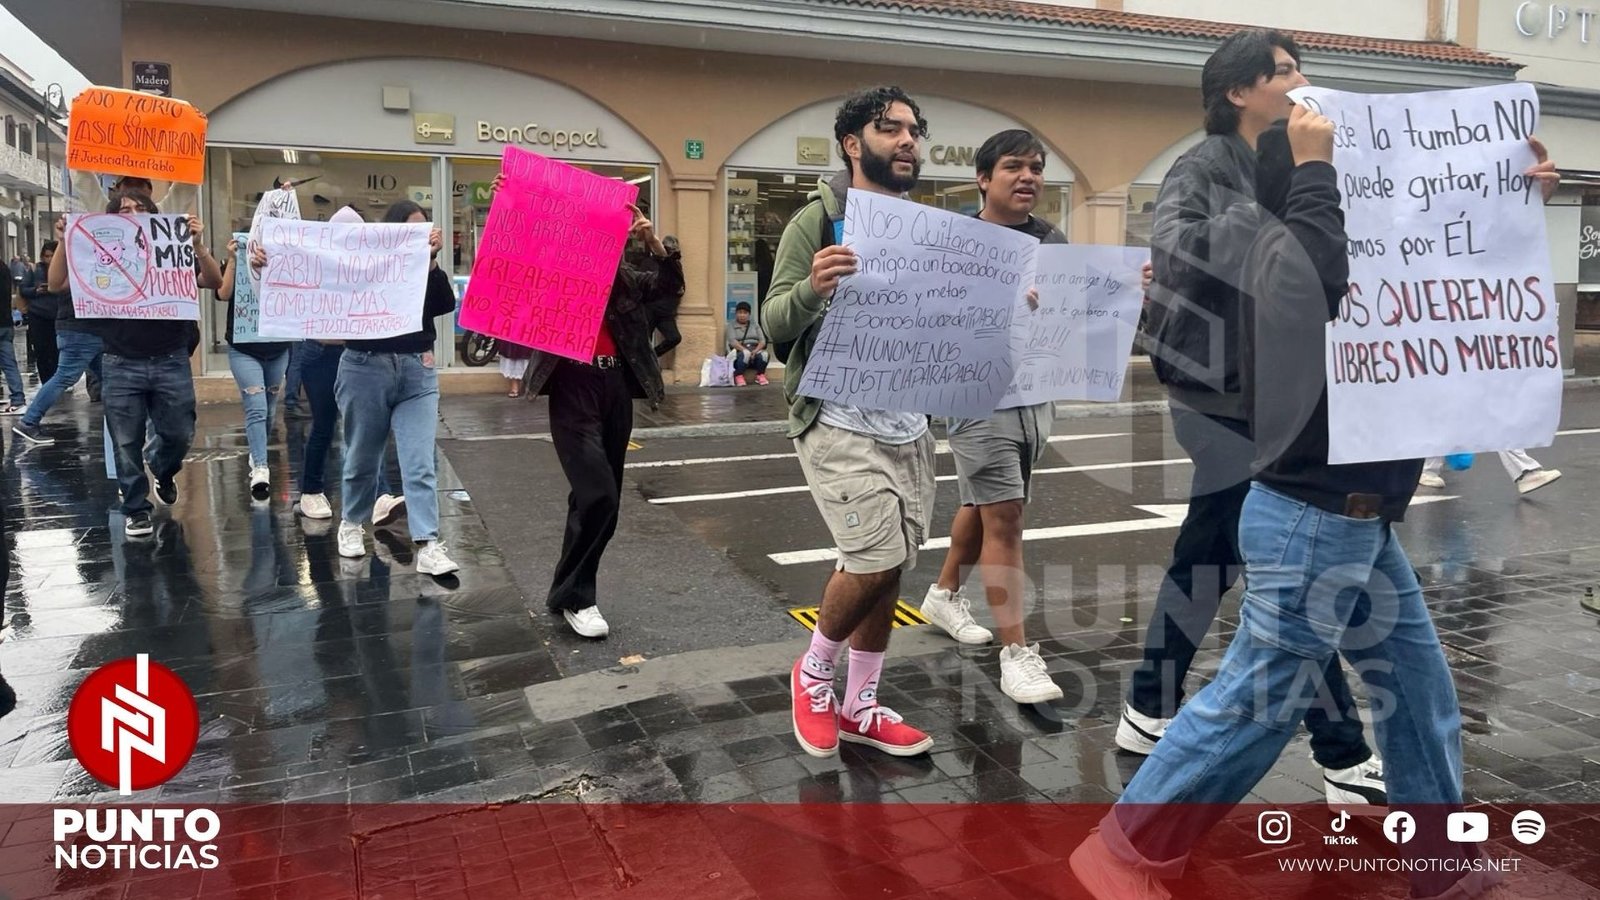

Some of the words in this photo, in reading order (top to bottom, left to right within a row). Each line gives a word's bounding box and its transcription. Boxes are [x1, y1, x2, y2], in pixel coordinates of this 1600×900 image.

[136, 75, 169, 85] Madero
[87, 91, 114, 108] NO
[477, 120, 606, 151] BanCoppel
[1368, 105, 1391, 150] la
[1403, 108, 1491, 150] tumba
[1494, 99, 1535, 141] NO
[70, 149, 175, 172] #JusticiaParaPablo
[930, 145, 979, 166] CAN
[1345, 166, 1394, 209] puede
[1408, 162, 1489, 212] gritar,
[1497, 158, 1535, 205] Hoy
[527, 191, 586, 222] TODOS
[150, 216, 191, 243] NO
[495, 209, 526, 234] NOS
[852, 198, 903, 239] Nos
[911, 210, 985, 258] Quitaron
[988, 248, 999, 261] a
[1001, 250, 1018, 265] un
[272, 224, 309, 250] QUE
[490, 234, 523, 257] RON
[1346, 238, 1386, 259] amos
[1399, 235, 1436, 266] por
[1444, 211, 1486, 258] ÉL
[149, 266, 197, 300] PUERCOS
[265, 253, 323, 286] PABLO
[337, 254, 360, 285] NO
[364, 253, 413, 284] QUEDE
[942, 254, 998, 280] boxeador
[1000, 272, 1021, 286] con
[1104, 271, 1121, 296] hoy
[926, 280, 967, 299] metas
[1333, 282, 1370, 328] OS
[1377, 276, 1546, 327] QUEREMOS
[265, 291, 306, 318] COMO
[310, 292, 342, 315] UNO
[466, 295, 491, 312] NO
[500, 300, 521, 319] SE
[488, 316, 512, 338] LA
[520, 325, 595, 354] HISTORIA
[1332, 340, 1400, 385] LIBRES
[1401, 337, 1449, 379] NO
[1454, 334, 1558, 373] MUERTOS
